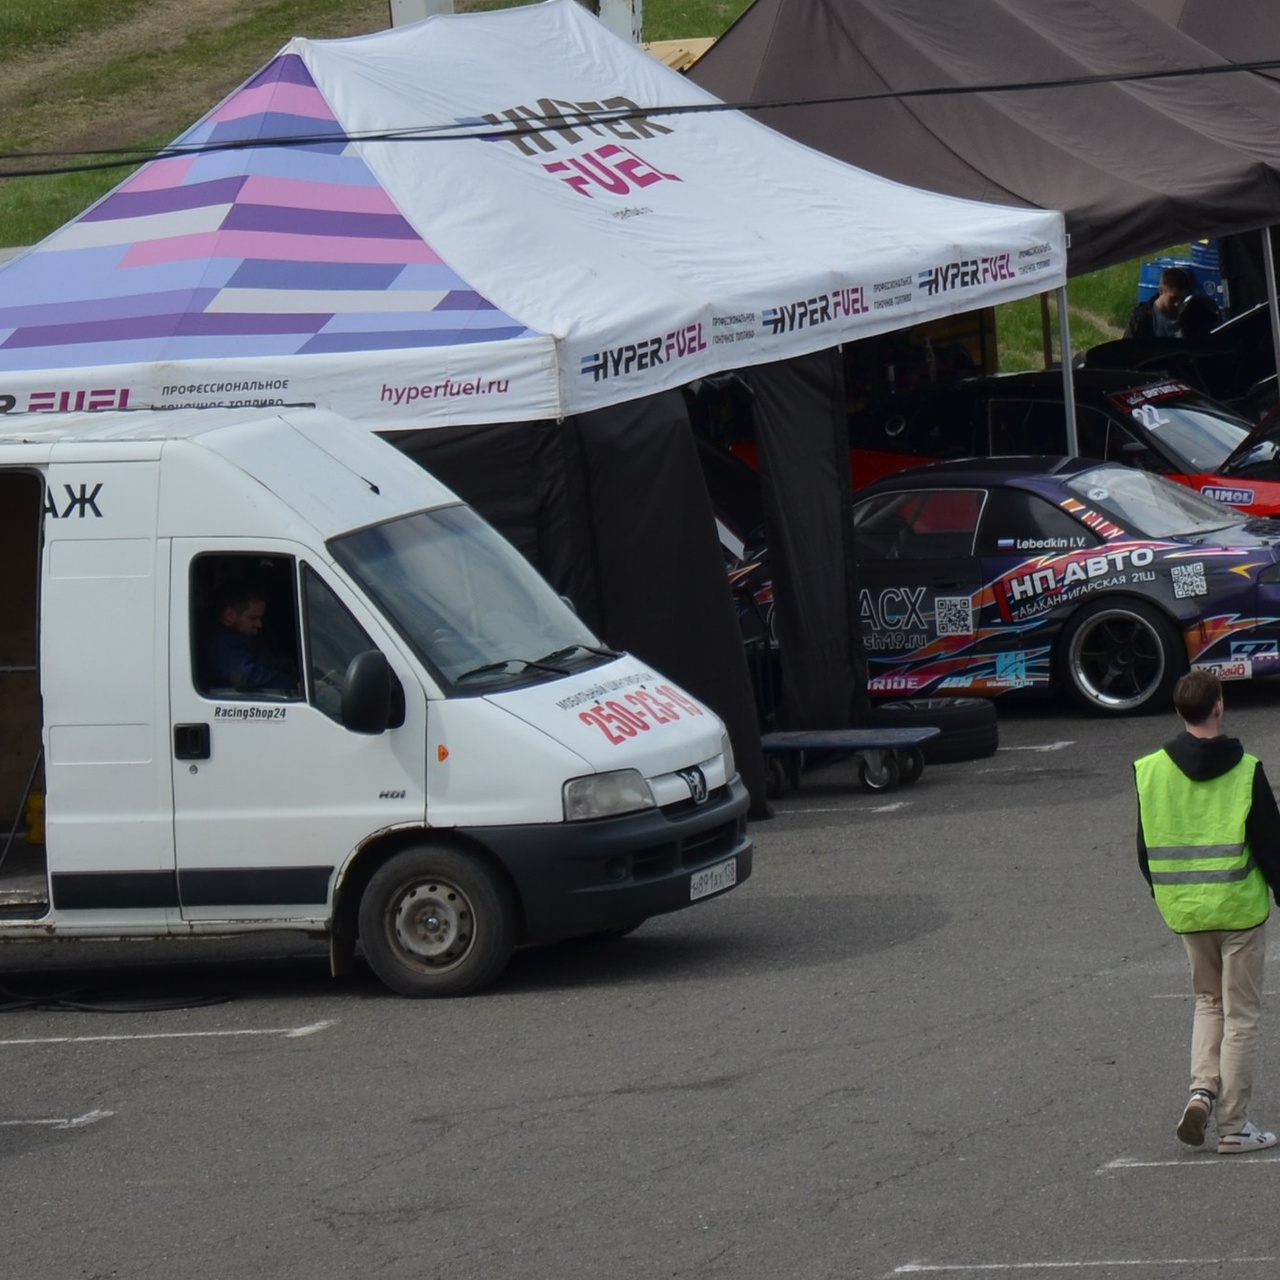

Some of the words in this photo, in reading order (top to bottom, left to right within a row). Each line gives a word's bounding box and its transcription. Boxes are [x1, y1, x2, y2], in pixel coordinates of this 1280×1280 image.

[481, 96, 675, 156] HYPER
[541, 144, 684, 198] FUEL
[162, 379, 289, 396] ПРОФЕССИОНАЛЬНОЕ
[380, 376, 509, 406] hyperfuel.ru
[1131, 404, 1171, 431] 22
[1203, 489, 1251, 503] AIMOL
[1016, 538, 1068, 550] Lebedkin
[1069, 537, 1086, 548] I.V.
[863, 631, 928, 650] sh19.ru
[214, 706, 286, 719] RacingShop24
